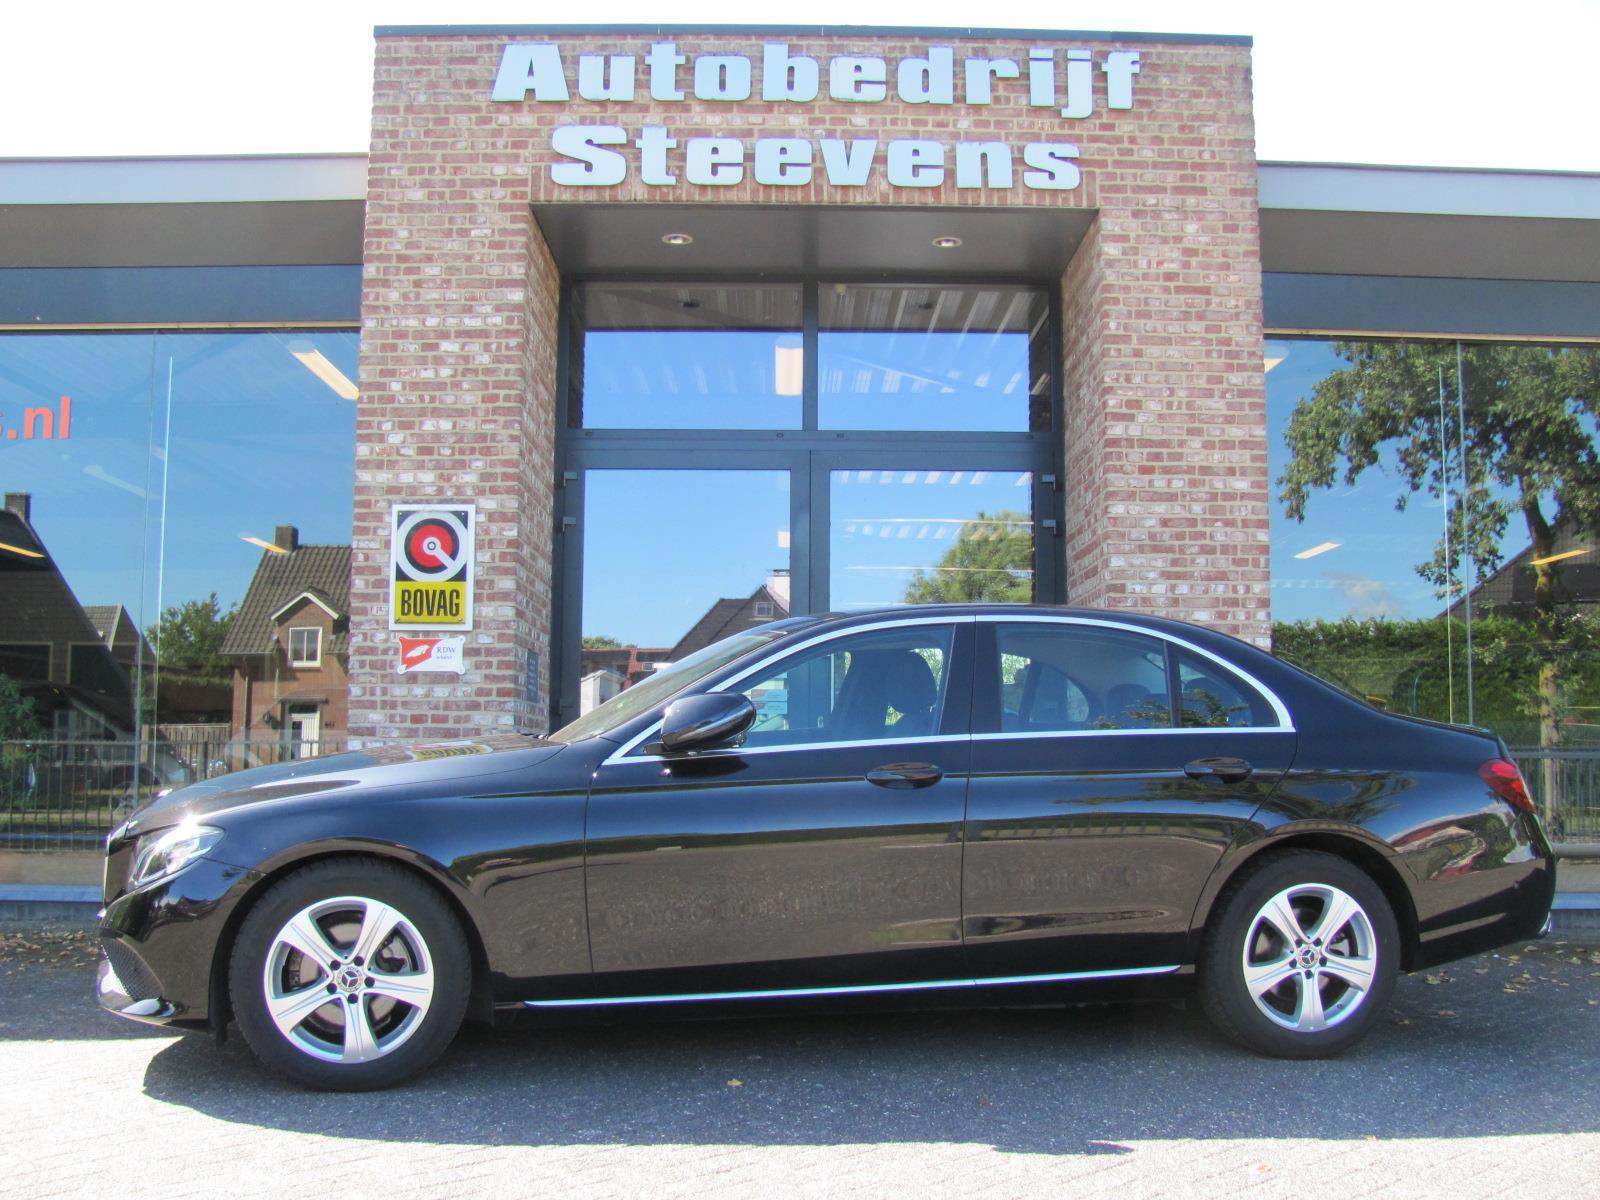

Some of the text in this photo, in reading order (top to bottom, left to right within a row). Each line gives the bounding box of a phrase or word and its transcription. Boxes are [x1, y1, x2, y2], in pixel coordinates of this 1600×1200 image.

[491, 42, 1141, 120] Autobedrijf
[550, 124, 1081, 190] Steevens
[0, 394, 71, 439] .nl
[400, 589, 461, 617] BOVAG
[436, 646, 456, 654] RDW
